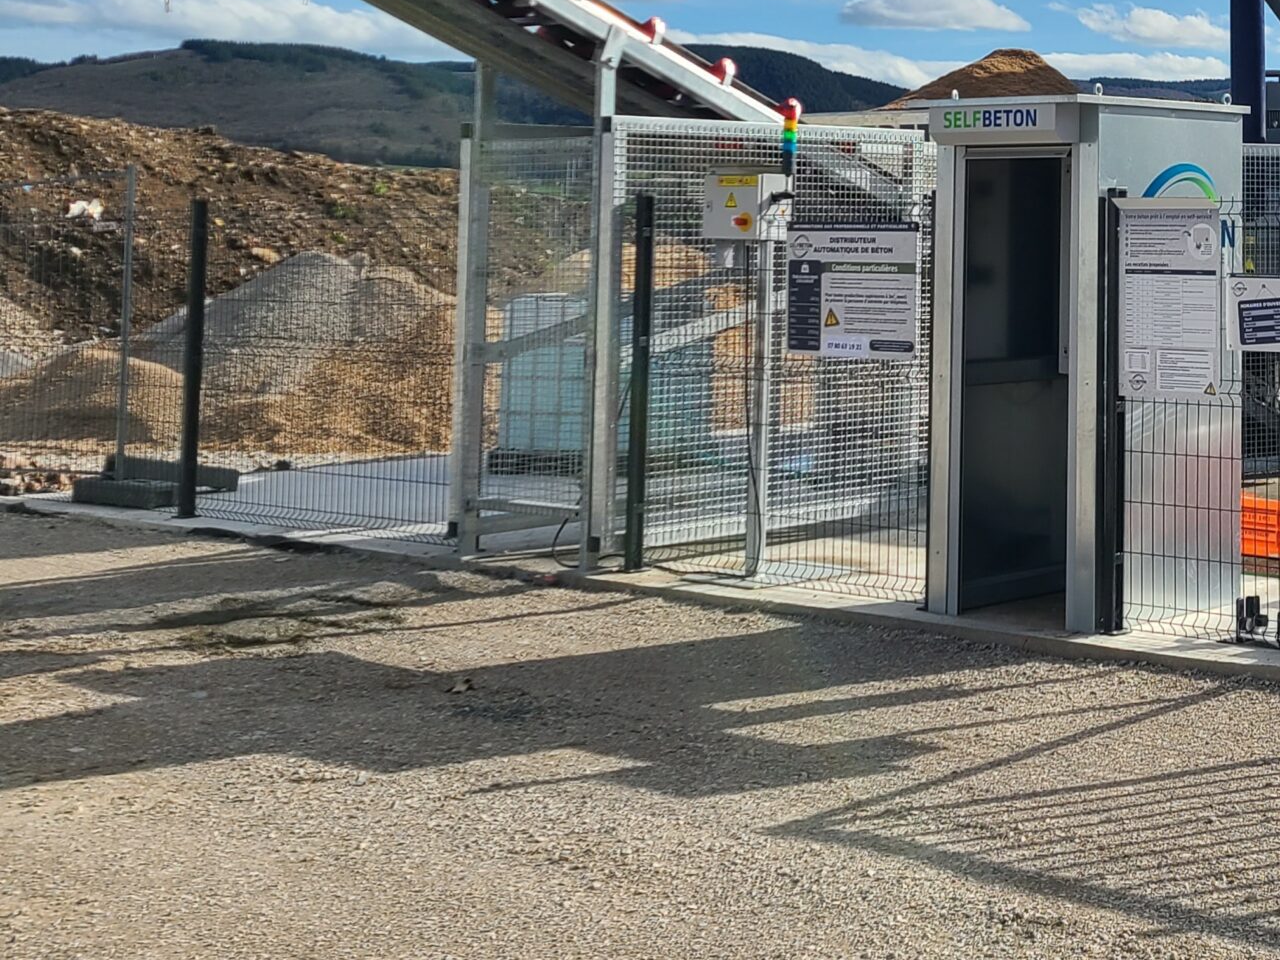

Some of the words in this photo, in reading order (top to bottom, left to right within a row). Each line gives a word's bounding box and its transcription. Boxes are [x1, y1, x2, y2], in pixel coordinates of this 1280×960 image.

[943, 109, 1037, 128] SELFBETON
[813, 246, 859, 254] AUTOMATIQUE
[831, 263, 861, 272] Conditions
[862, 263, 898, 273] particulières
